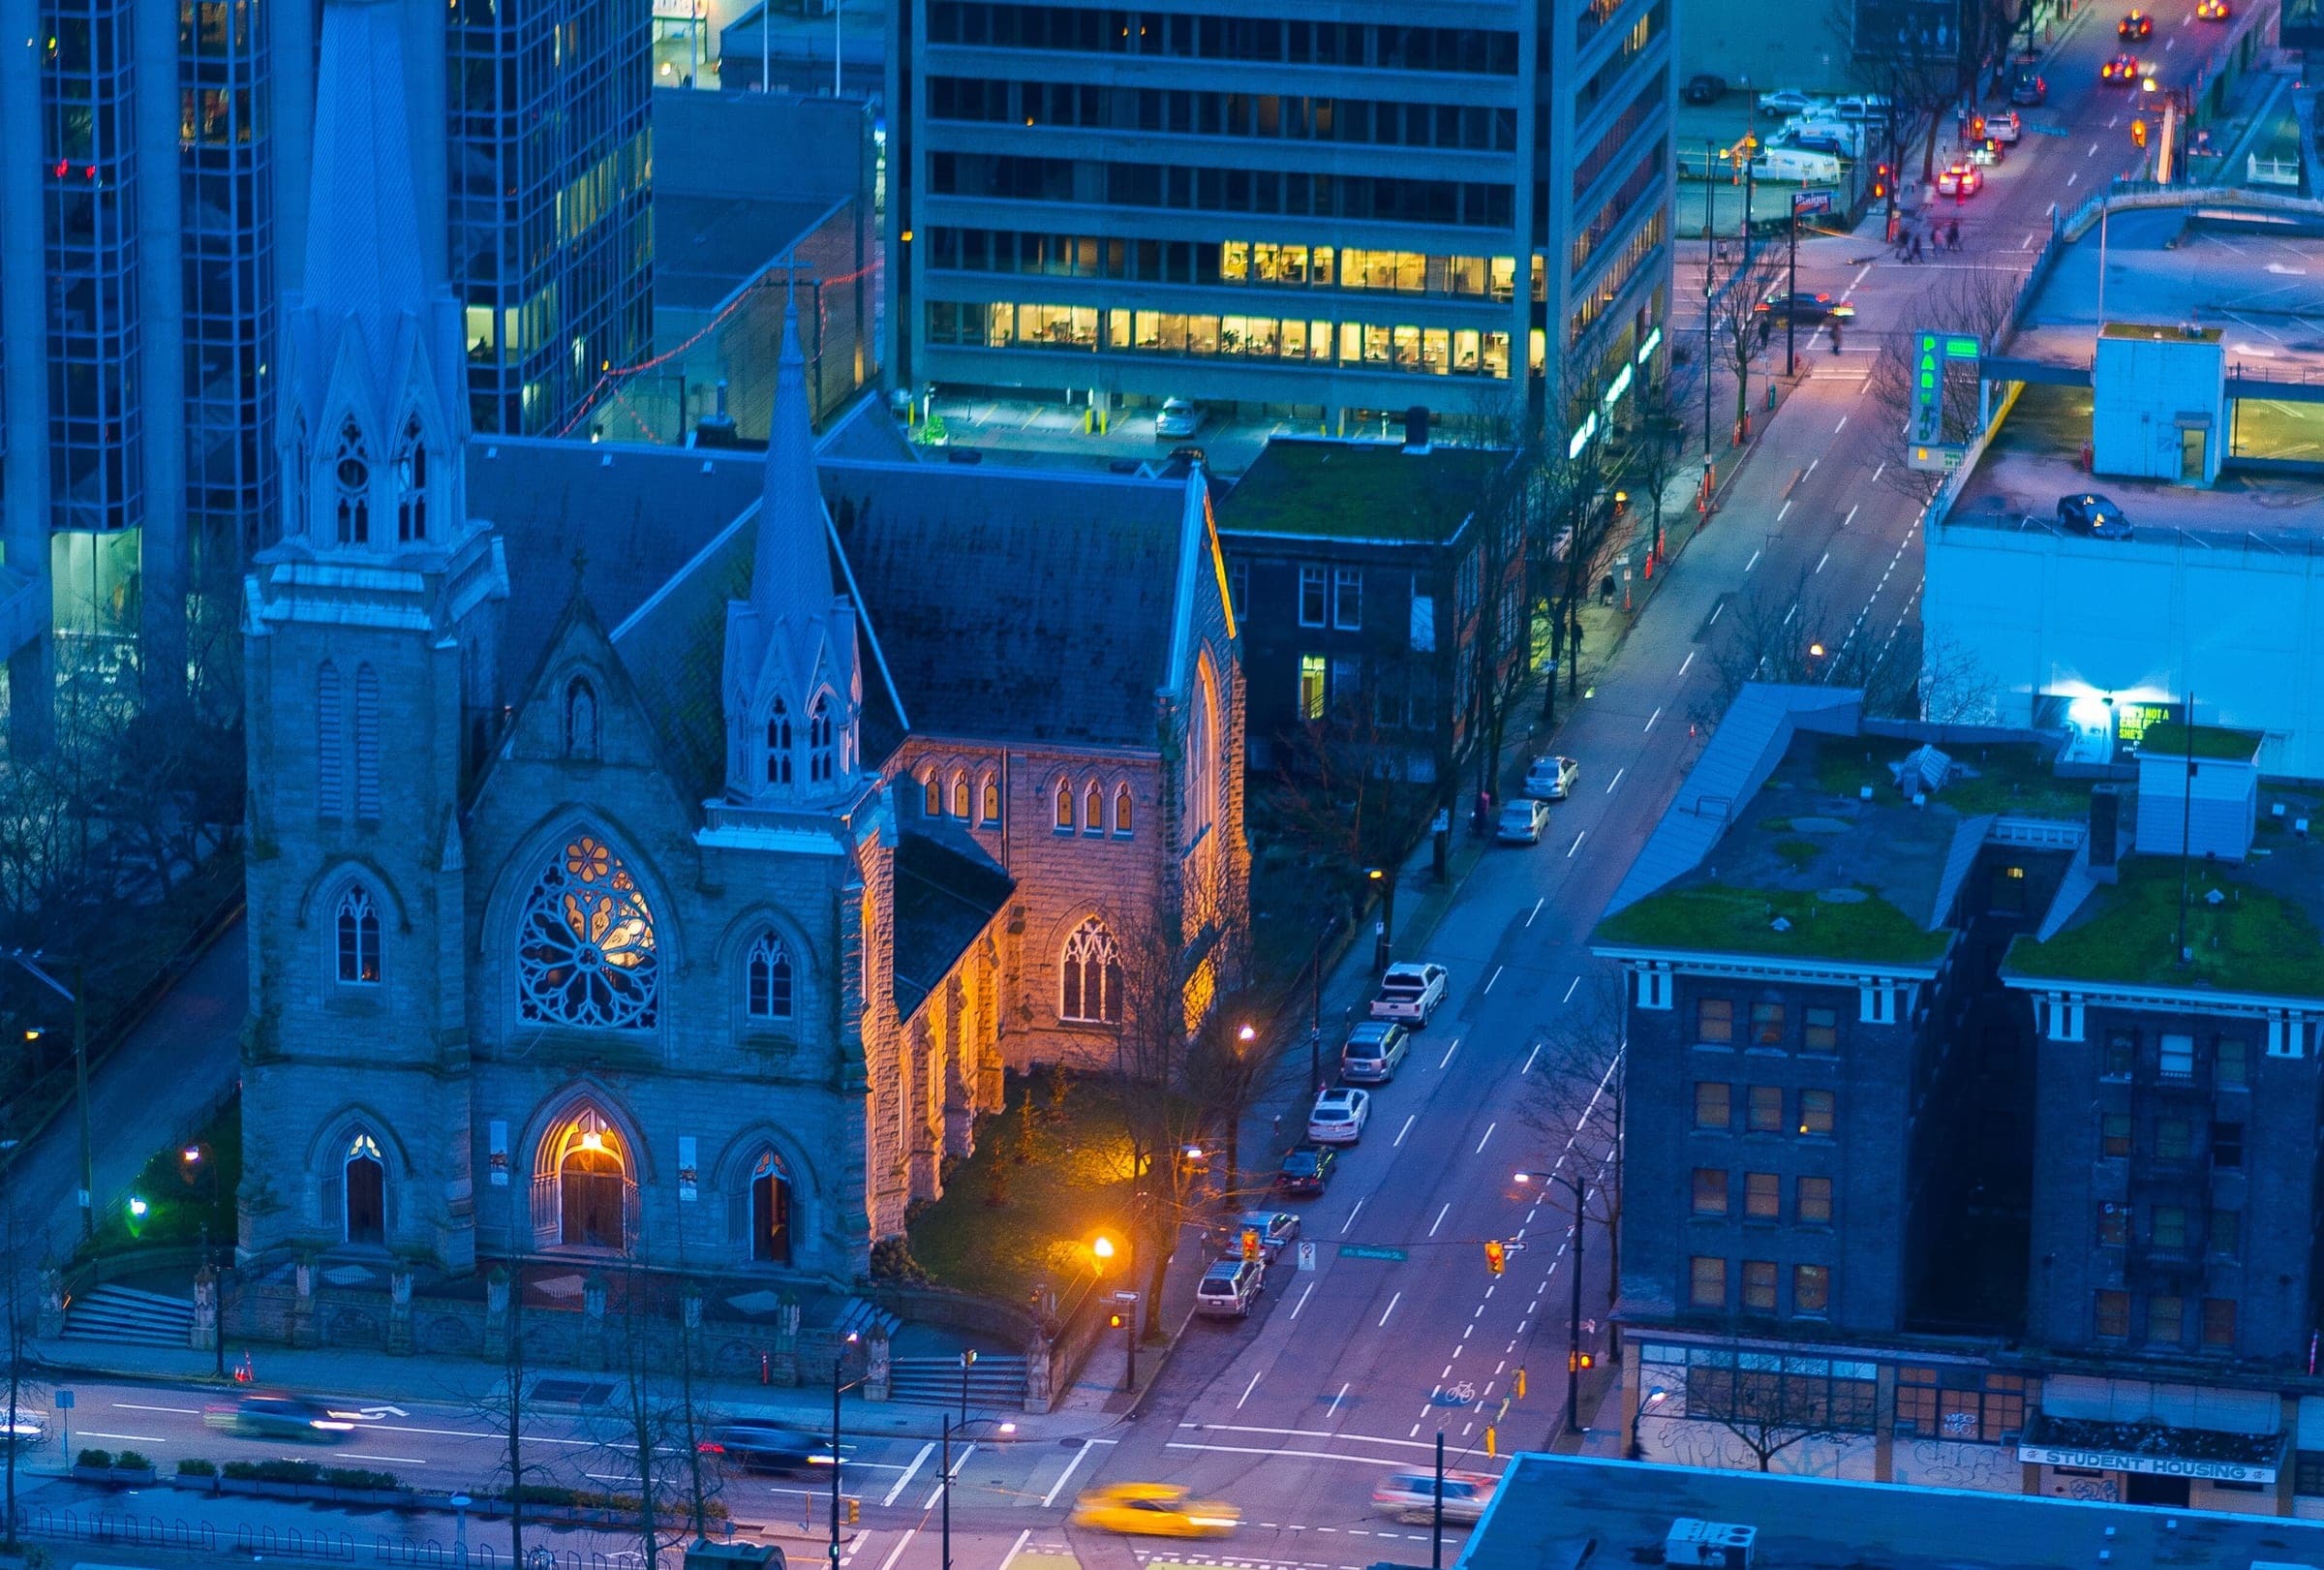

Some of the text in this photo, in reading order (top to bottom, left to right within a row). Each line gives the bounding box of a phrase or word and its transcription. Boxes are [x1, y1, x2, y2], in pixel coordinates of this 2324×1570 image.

[2145, 707, 2162, 720] NOT
[2162, 709, 2169, 721] A
[2119, 728, 2143, 740] SHE'S
[2045, 1451, 2247, 1480] STUDENT HOUSING
